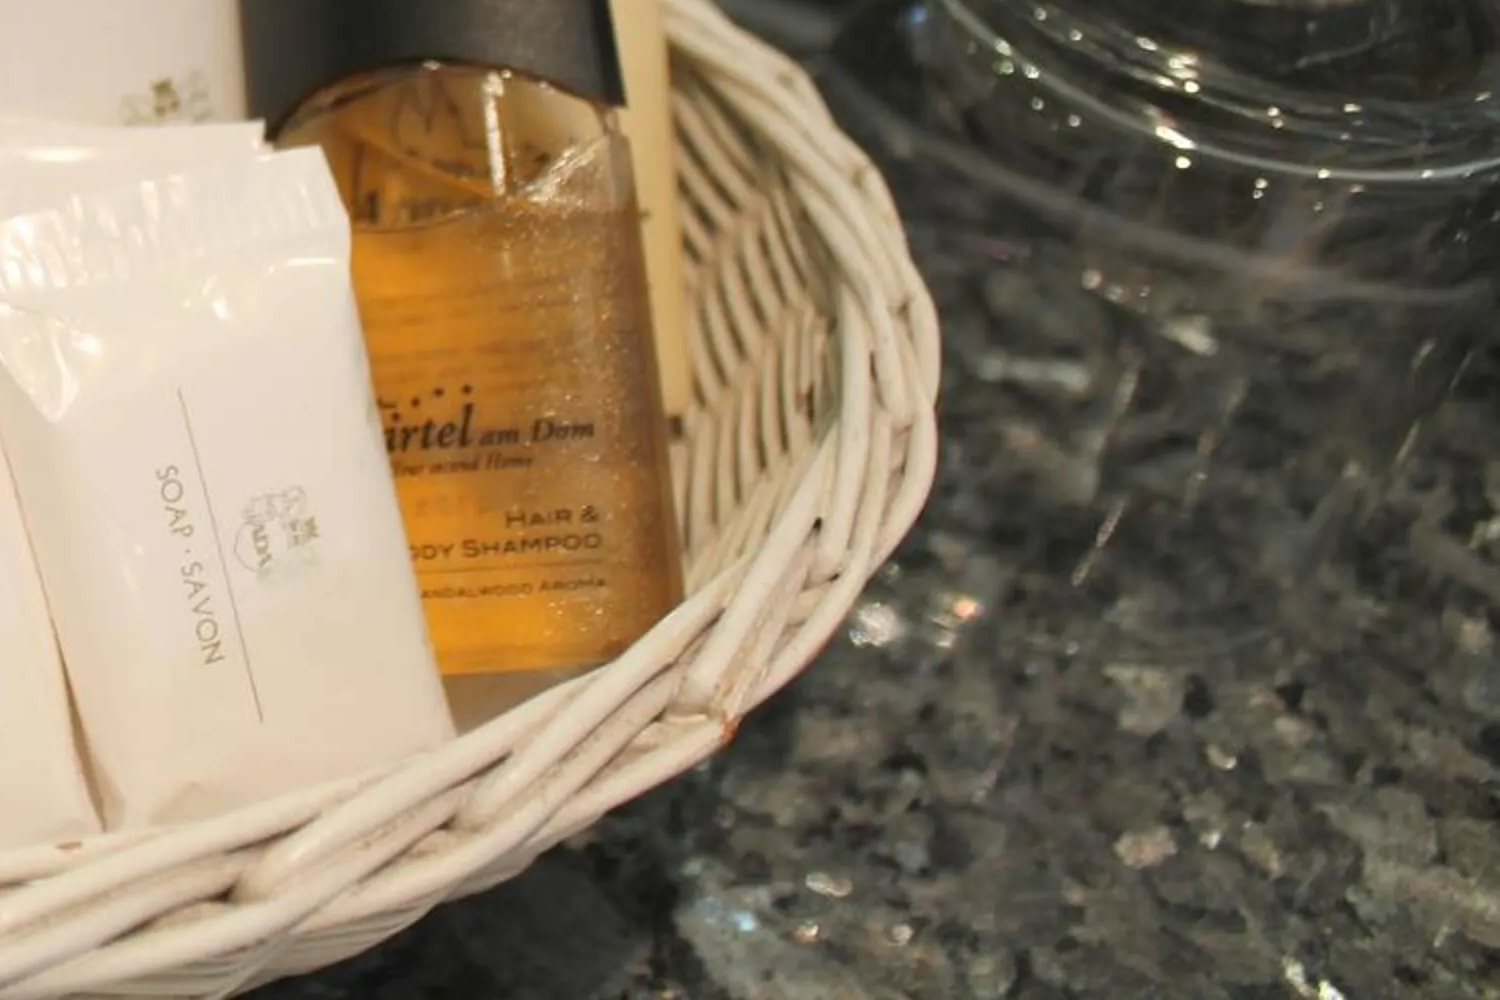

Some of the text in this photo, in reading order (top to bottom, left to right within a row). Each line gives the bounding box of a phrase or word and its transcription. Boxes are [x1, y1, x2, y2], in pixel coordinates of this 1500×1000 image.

[531, 418, 595, 443] Dom
[505, 504, 600, 529] HAIR &
[461, 532, 603, 559] SHAMPOO
[156, 465, 194, 538] SOAP
[181, 561, 226, 666] SAVON
